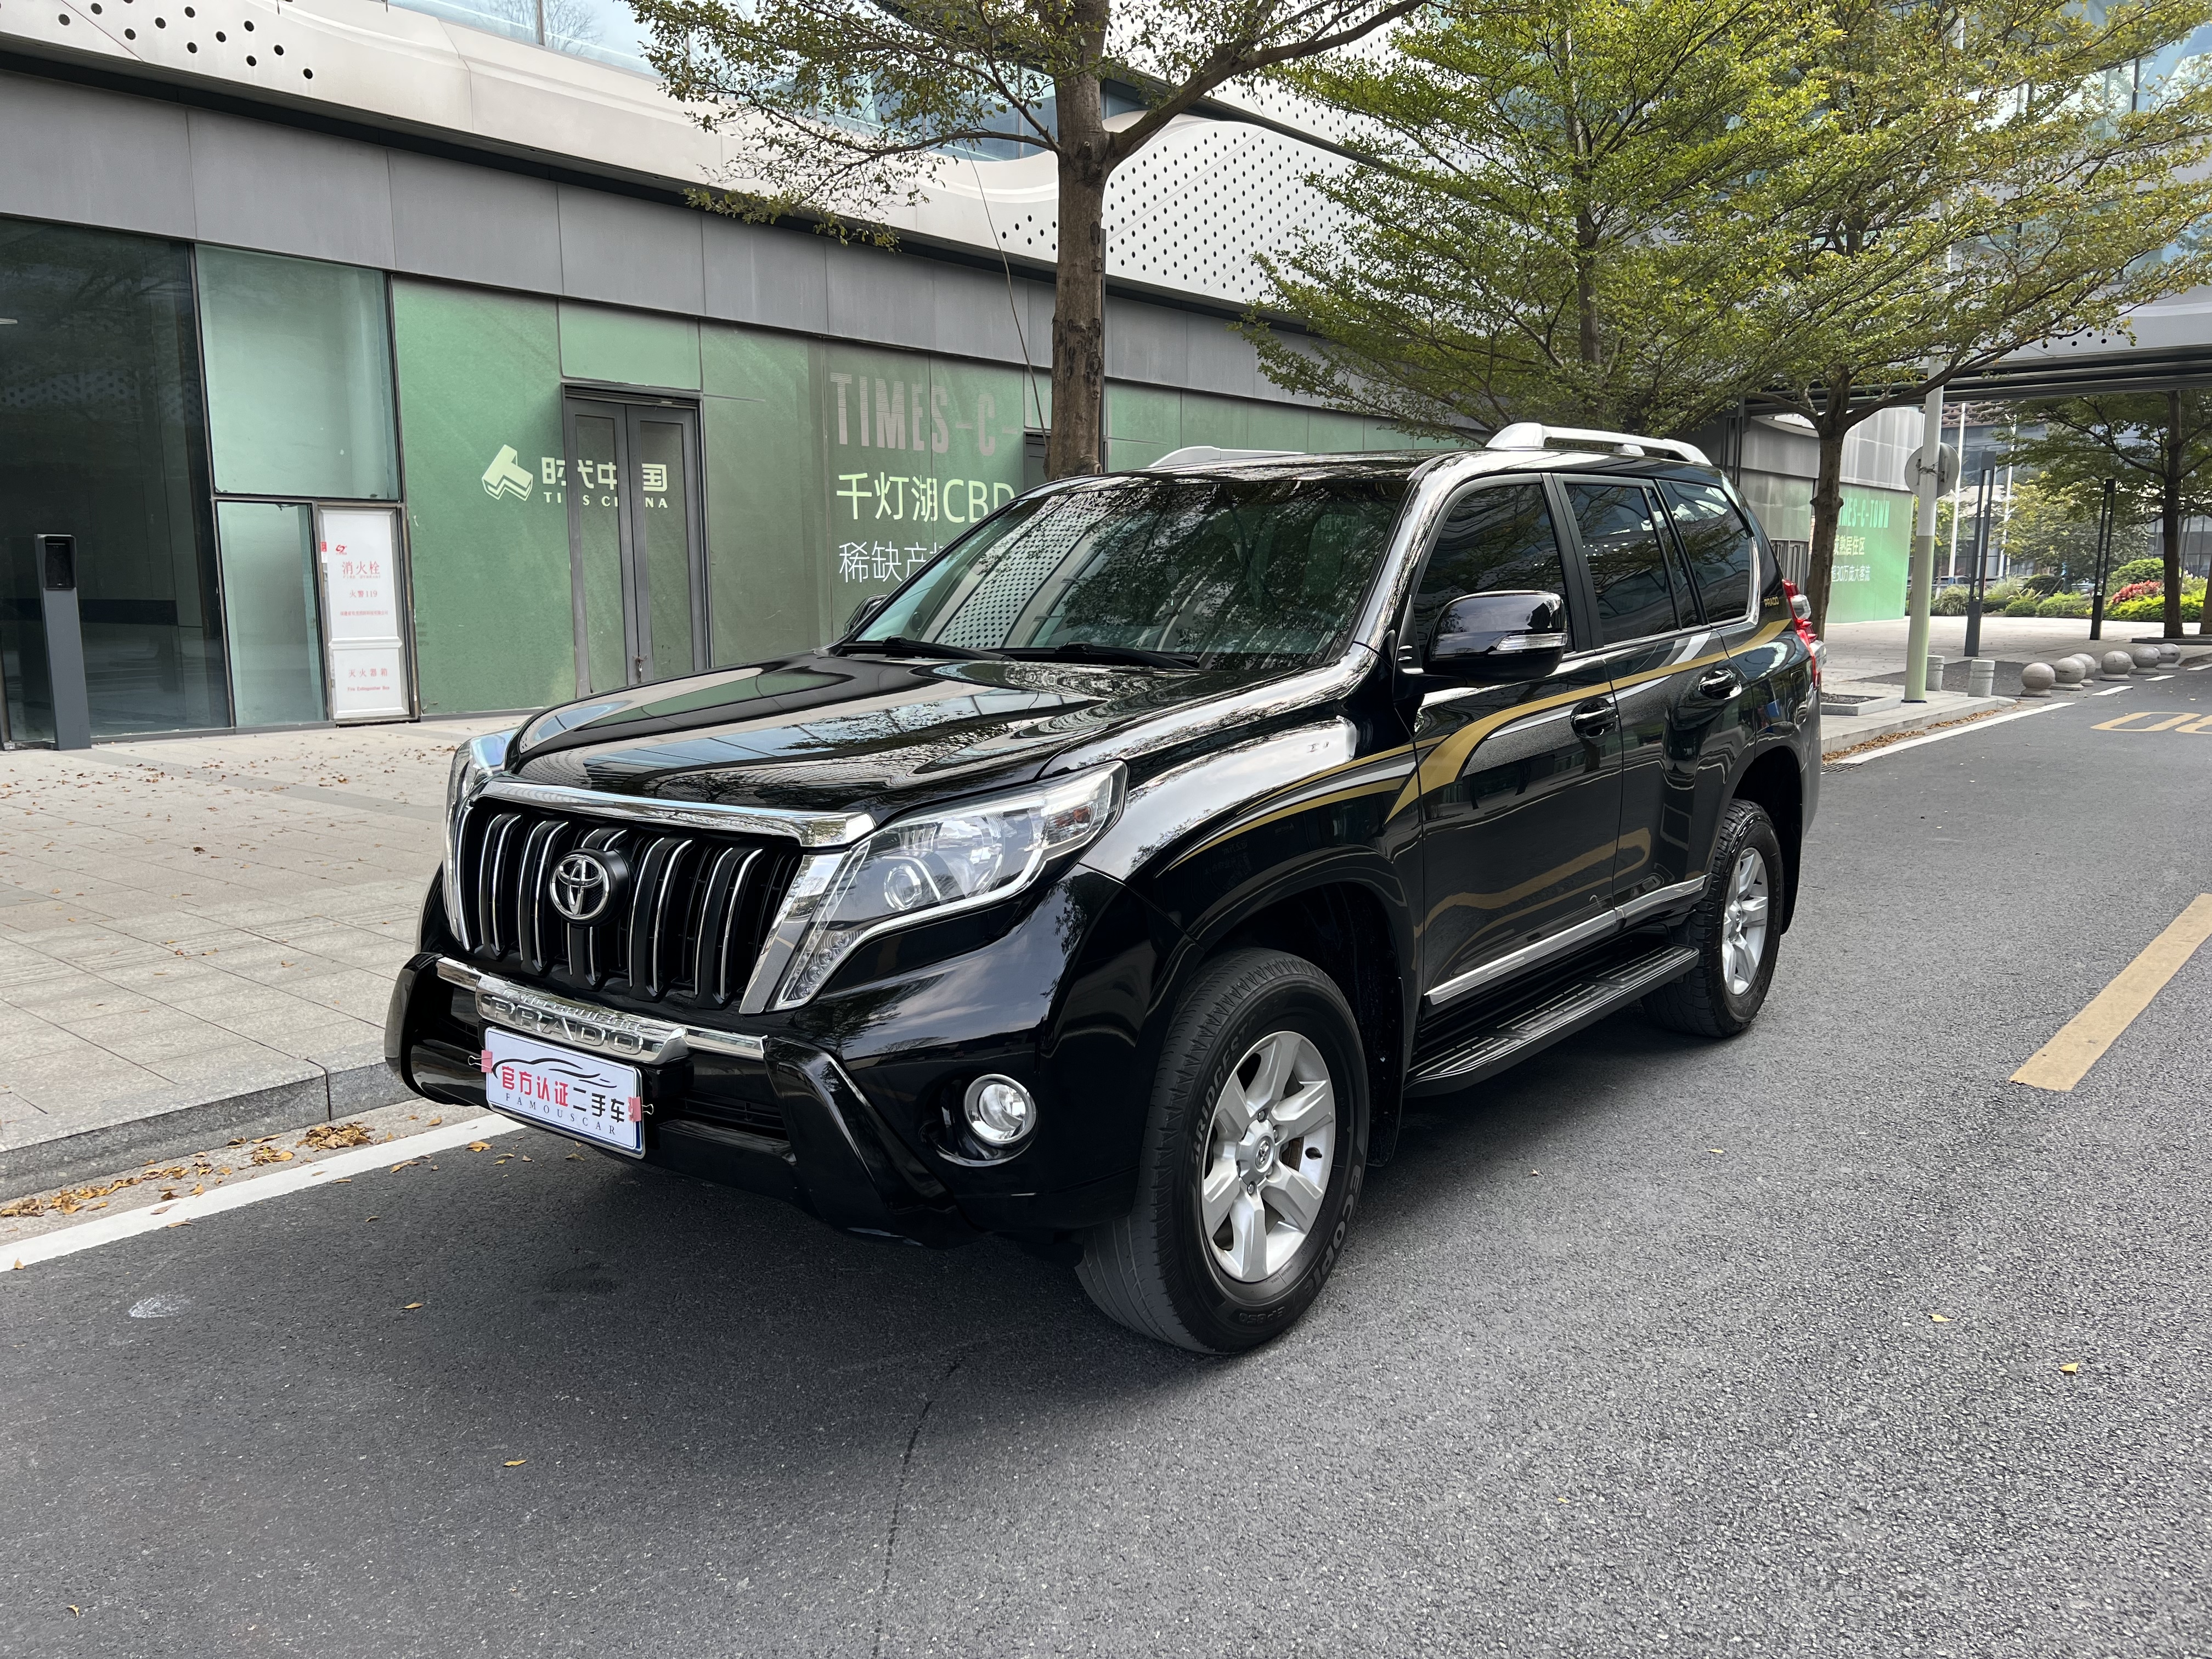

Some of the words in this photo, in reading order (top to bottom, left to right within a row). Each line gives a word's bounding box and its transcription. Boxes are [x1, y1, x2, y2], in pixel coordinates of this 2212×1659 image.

[543, 491, 590, 506] TIS
[601, 495, 668, 509] CNA
[837, 471, 1015, 523] 千灯湖CBD
[1838, 496, 1890, 528] IMES-C-TOWN
[342, 560, 380, 575] 消火栓
[839, 540, 944, 583] 稀缺产
[1763, 596, 1780, 607] PRADO
[348, 668, 388, 678] 灭火器箱
[503, 989, 549, 1008] LAND
[490, 995, 644, 1056] PRADO
[501, 1065, 625, 1123] 官方认证二手车
[505, 1092, 616, 1135] FAMOUSCAR
